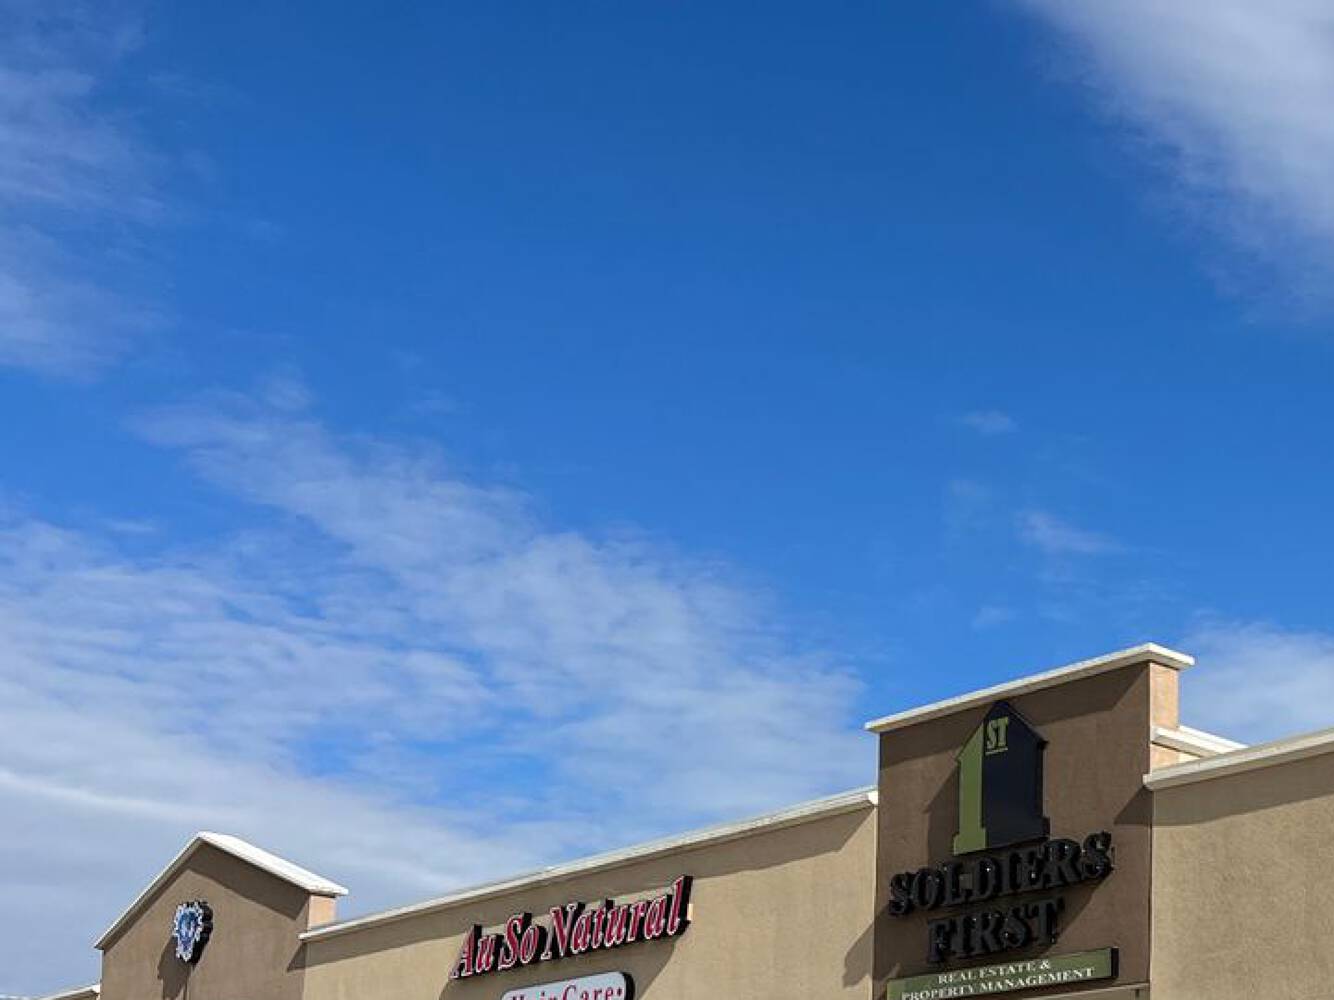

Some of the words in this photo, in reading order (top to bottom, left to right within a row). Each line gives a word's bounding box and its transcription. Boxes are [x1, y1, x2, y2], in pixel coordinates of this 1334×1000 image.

[984, 716, 1009, 751] ST
[889, 830, 1115, 916] SOLDIERS
[449, 923, 497, 980] Au
[498, 912, 540, 971] So
[541, 876, 692, 961] Natural
[926, 896, 1066, 964] FIRST
[938, 970, 974, 985] REAL
[978, 960, 1037, 978] ESTATE
[1039, 958, 1052, 971] &
[978, 966, 1096, 993] MANAGEMENT
